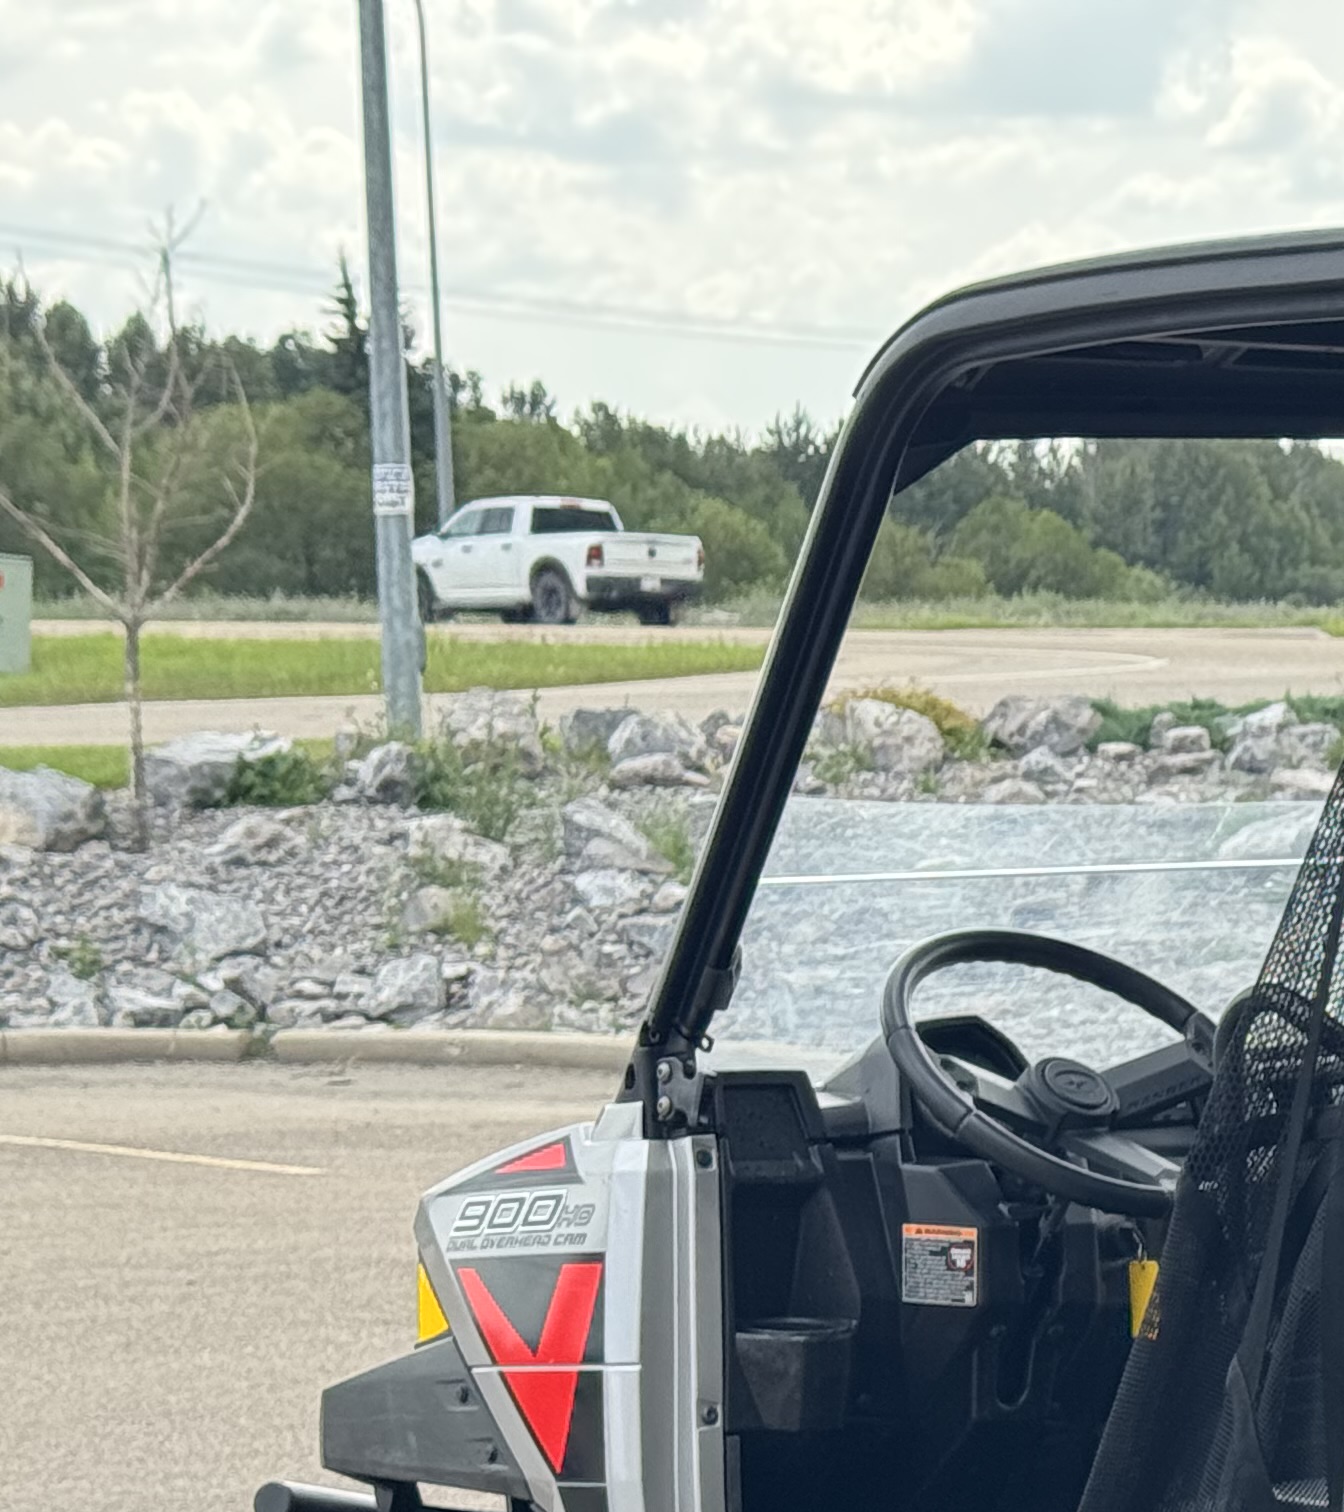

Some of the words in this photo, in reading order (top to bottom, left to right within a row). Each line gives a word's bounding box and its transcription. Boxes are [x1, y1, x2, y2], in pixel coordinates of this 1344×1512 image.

[449, 1190, 567, 1237] 900
[446, 1238, 478, 1252] DUAL
[480, 1234, 552, 1250] OVERHEAD
[553, 1231, 588, 1246] CAM
